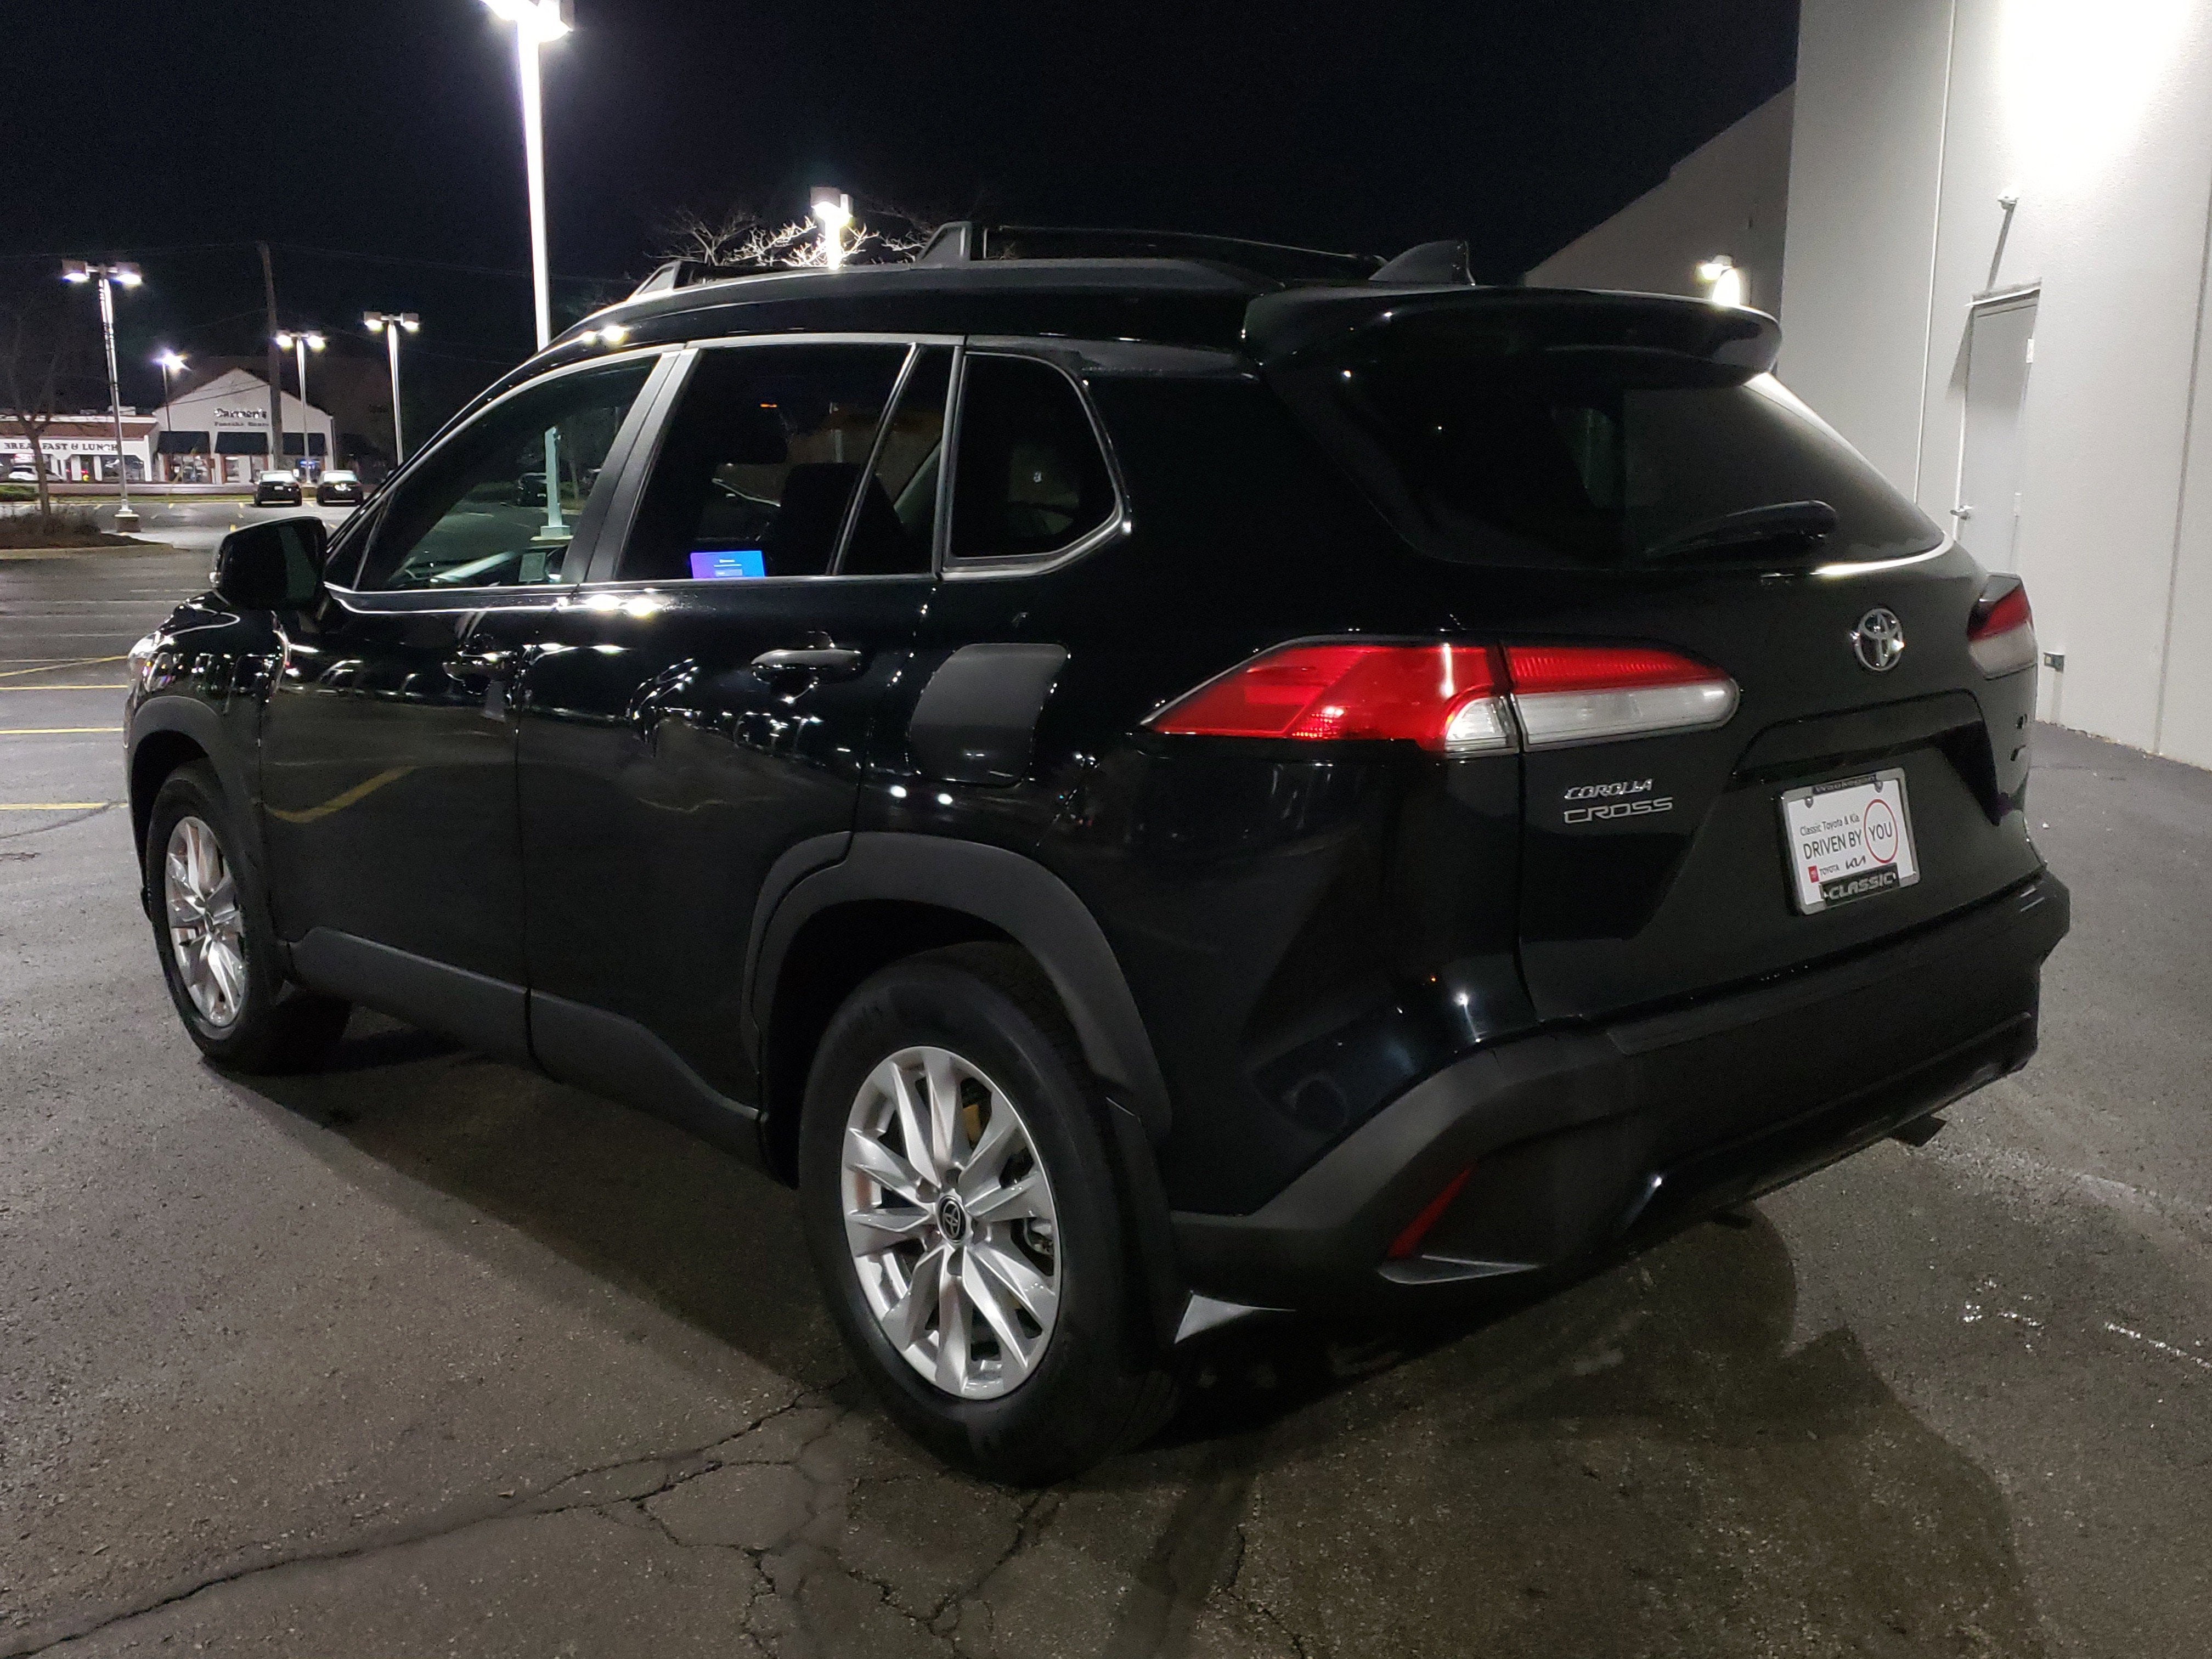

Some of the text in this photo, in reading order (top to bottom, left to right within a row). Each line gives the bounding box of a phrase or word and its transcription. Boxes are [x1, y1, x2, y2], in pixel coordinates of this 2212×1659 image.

[1564, 778, 1652, 800] COROLLA
[1564, 797, 1673, 823] CROSS
[1800, 814, 1860, 836] Classic Toyota & Kia
[1803, 821, 1893, 860] DRIVEN BY YOU
[1819, 864, 1840, 876] TOYOTA
[1829, 872, 1894, 900] CLASSIC
